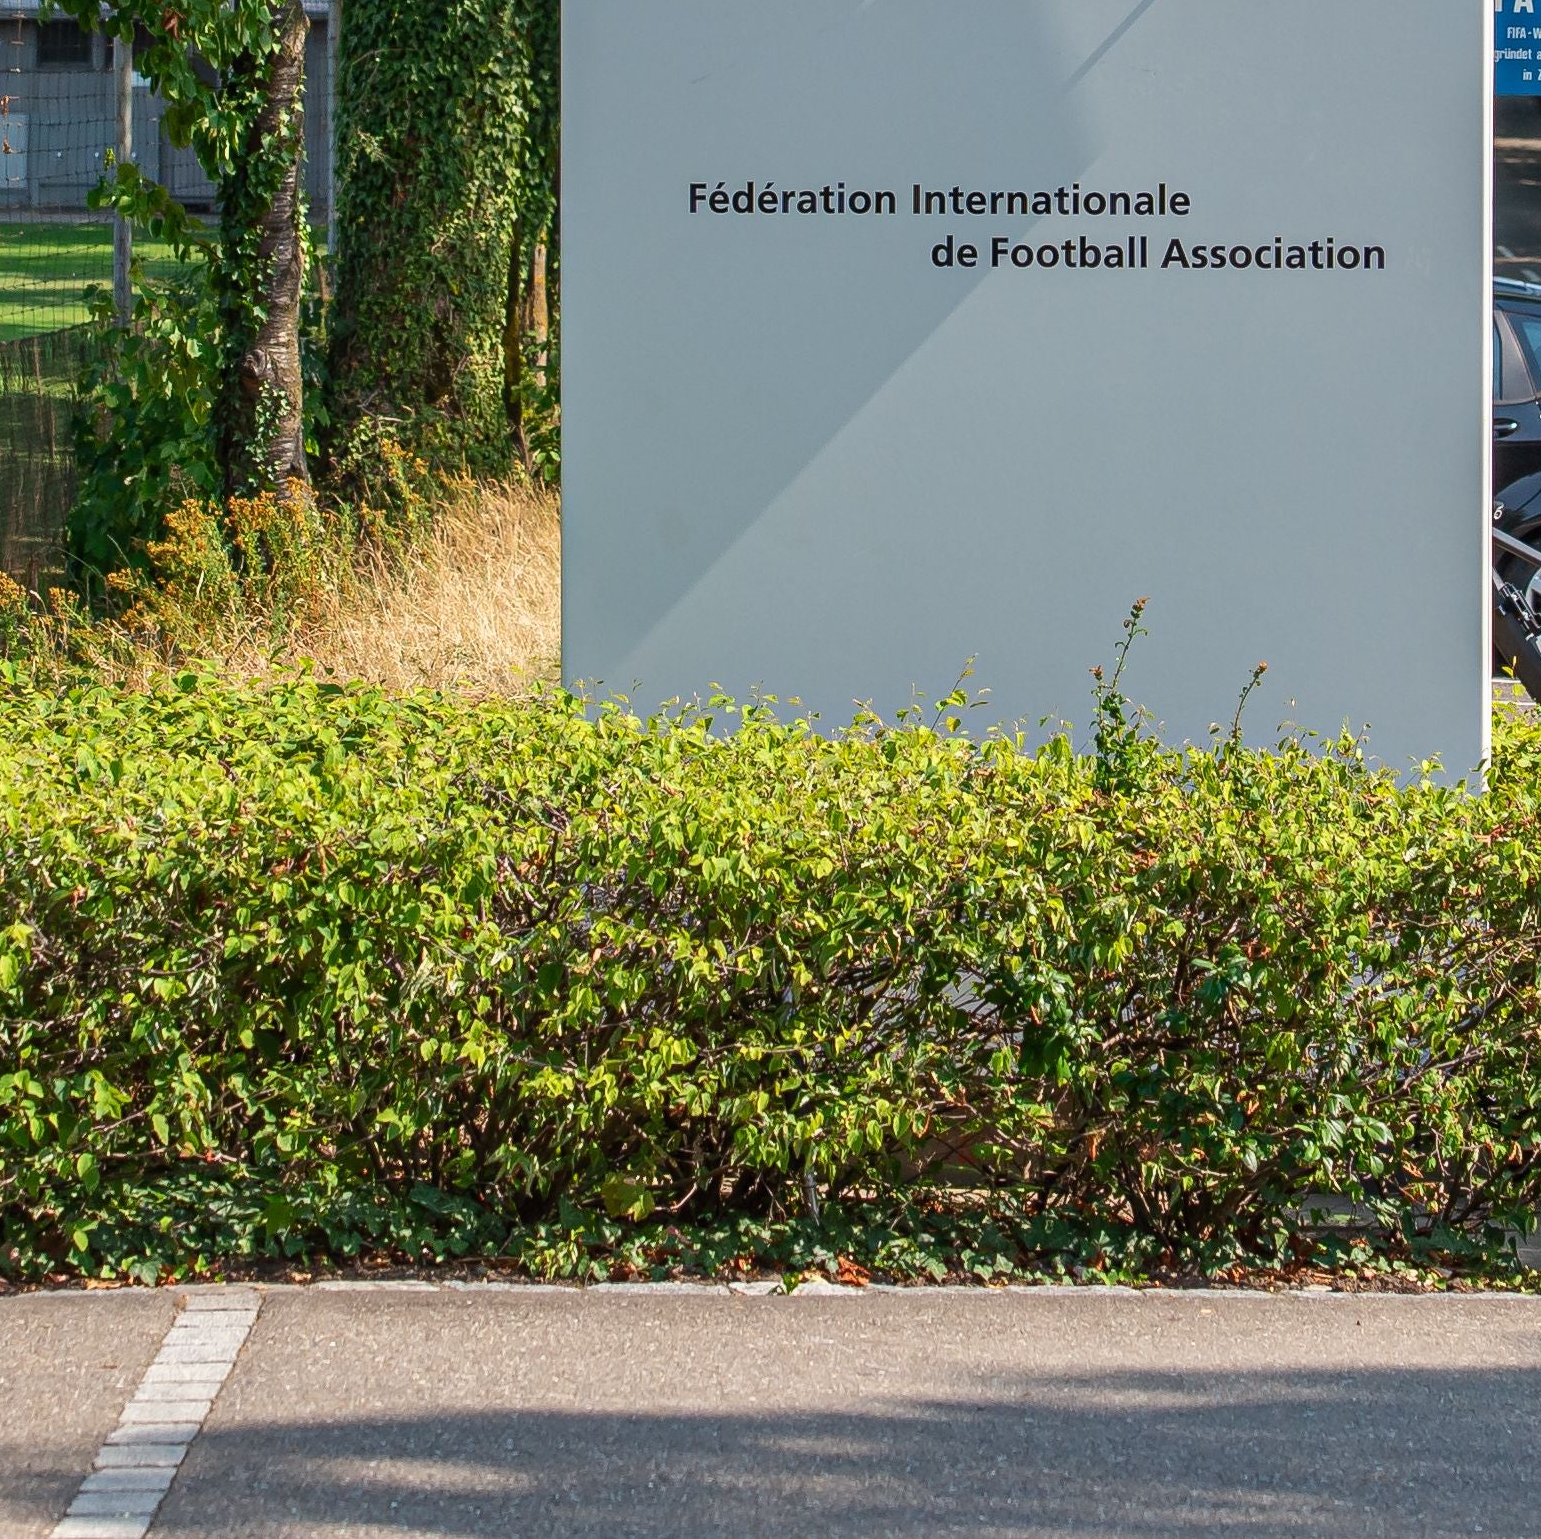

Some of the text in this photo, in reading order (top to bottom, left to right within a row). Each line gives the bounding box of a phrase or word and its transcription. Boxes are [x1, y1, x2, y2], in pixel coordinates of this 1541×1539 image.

[1522, 68, 1533, 81] in
[689, 181, 1191, 216] Fédération Internationale
[931, 234, 1386, 270] de Football Association
